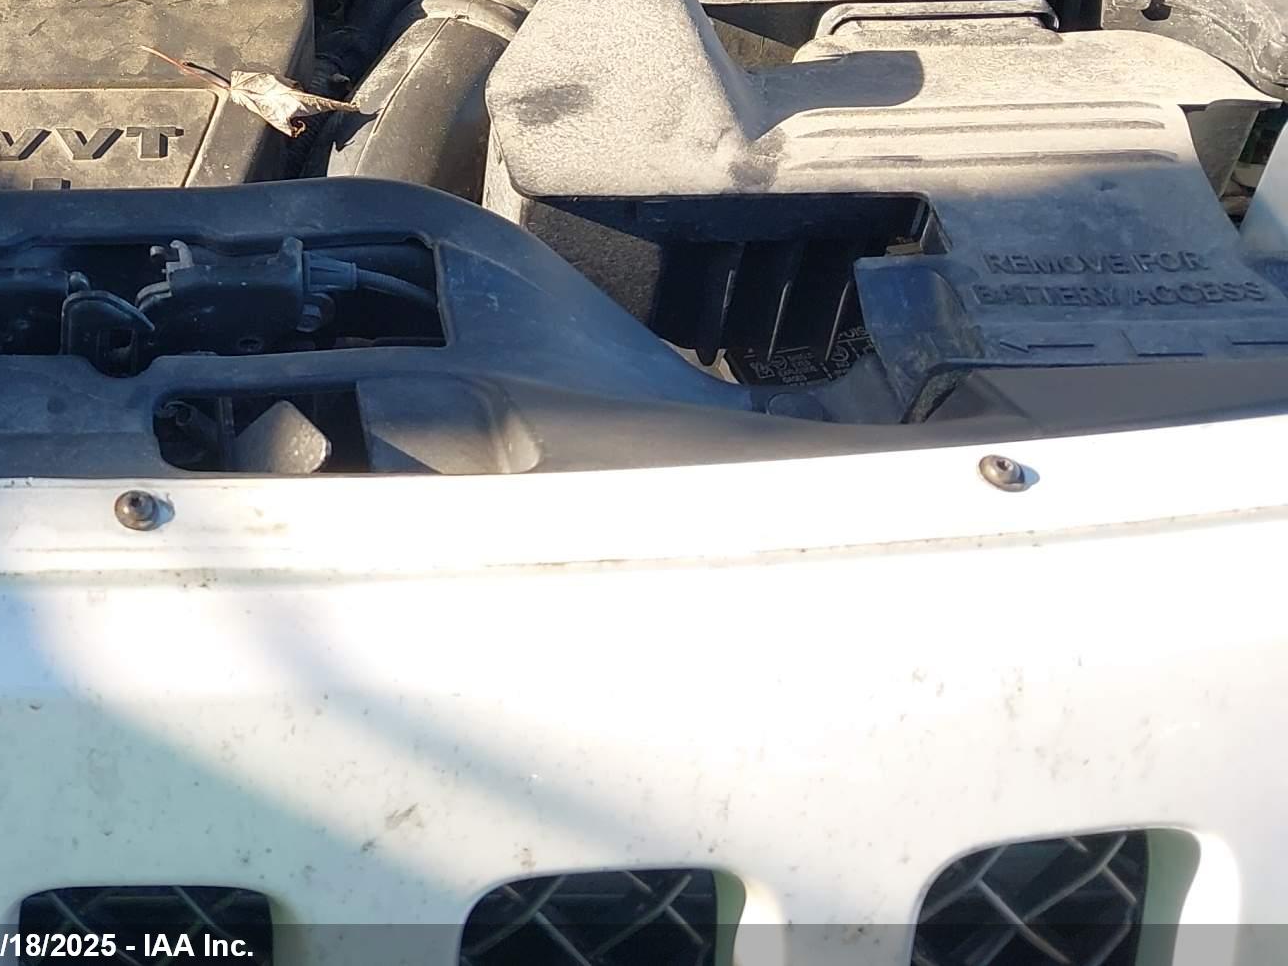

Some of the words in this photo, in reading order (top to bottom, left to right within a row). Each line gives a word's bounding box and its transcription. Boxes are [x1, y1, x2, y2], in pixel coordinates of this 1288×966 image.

[981, 252, 1130, 274] REMOVE
[1132, 250, 1209, 273] FOR
[971, 285, 1120, 306] BATTERY
[1131, 281, 1267, 306] ACCESS
